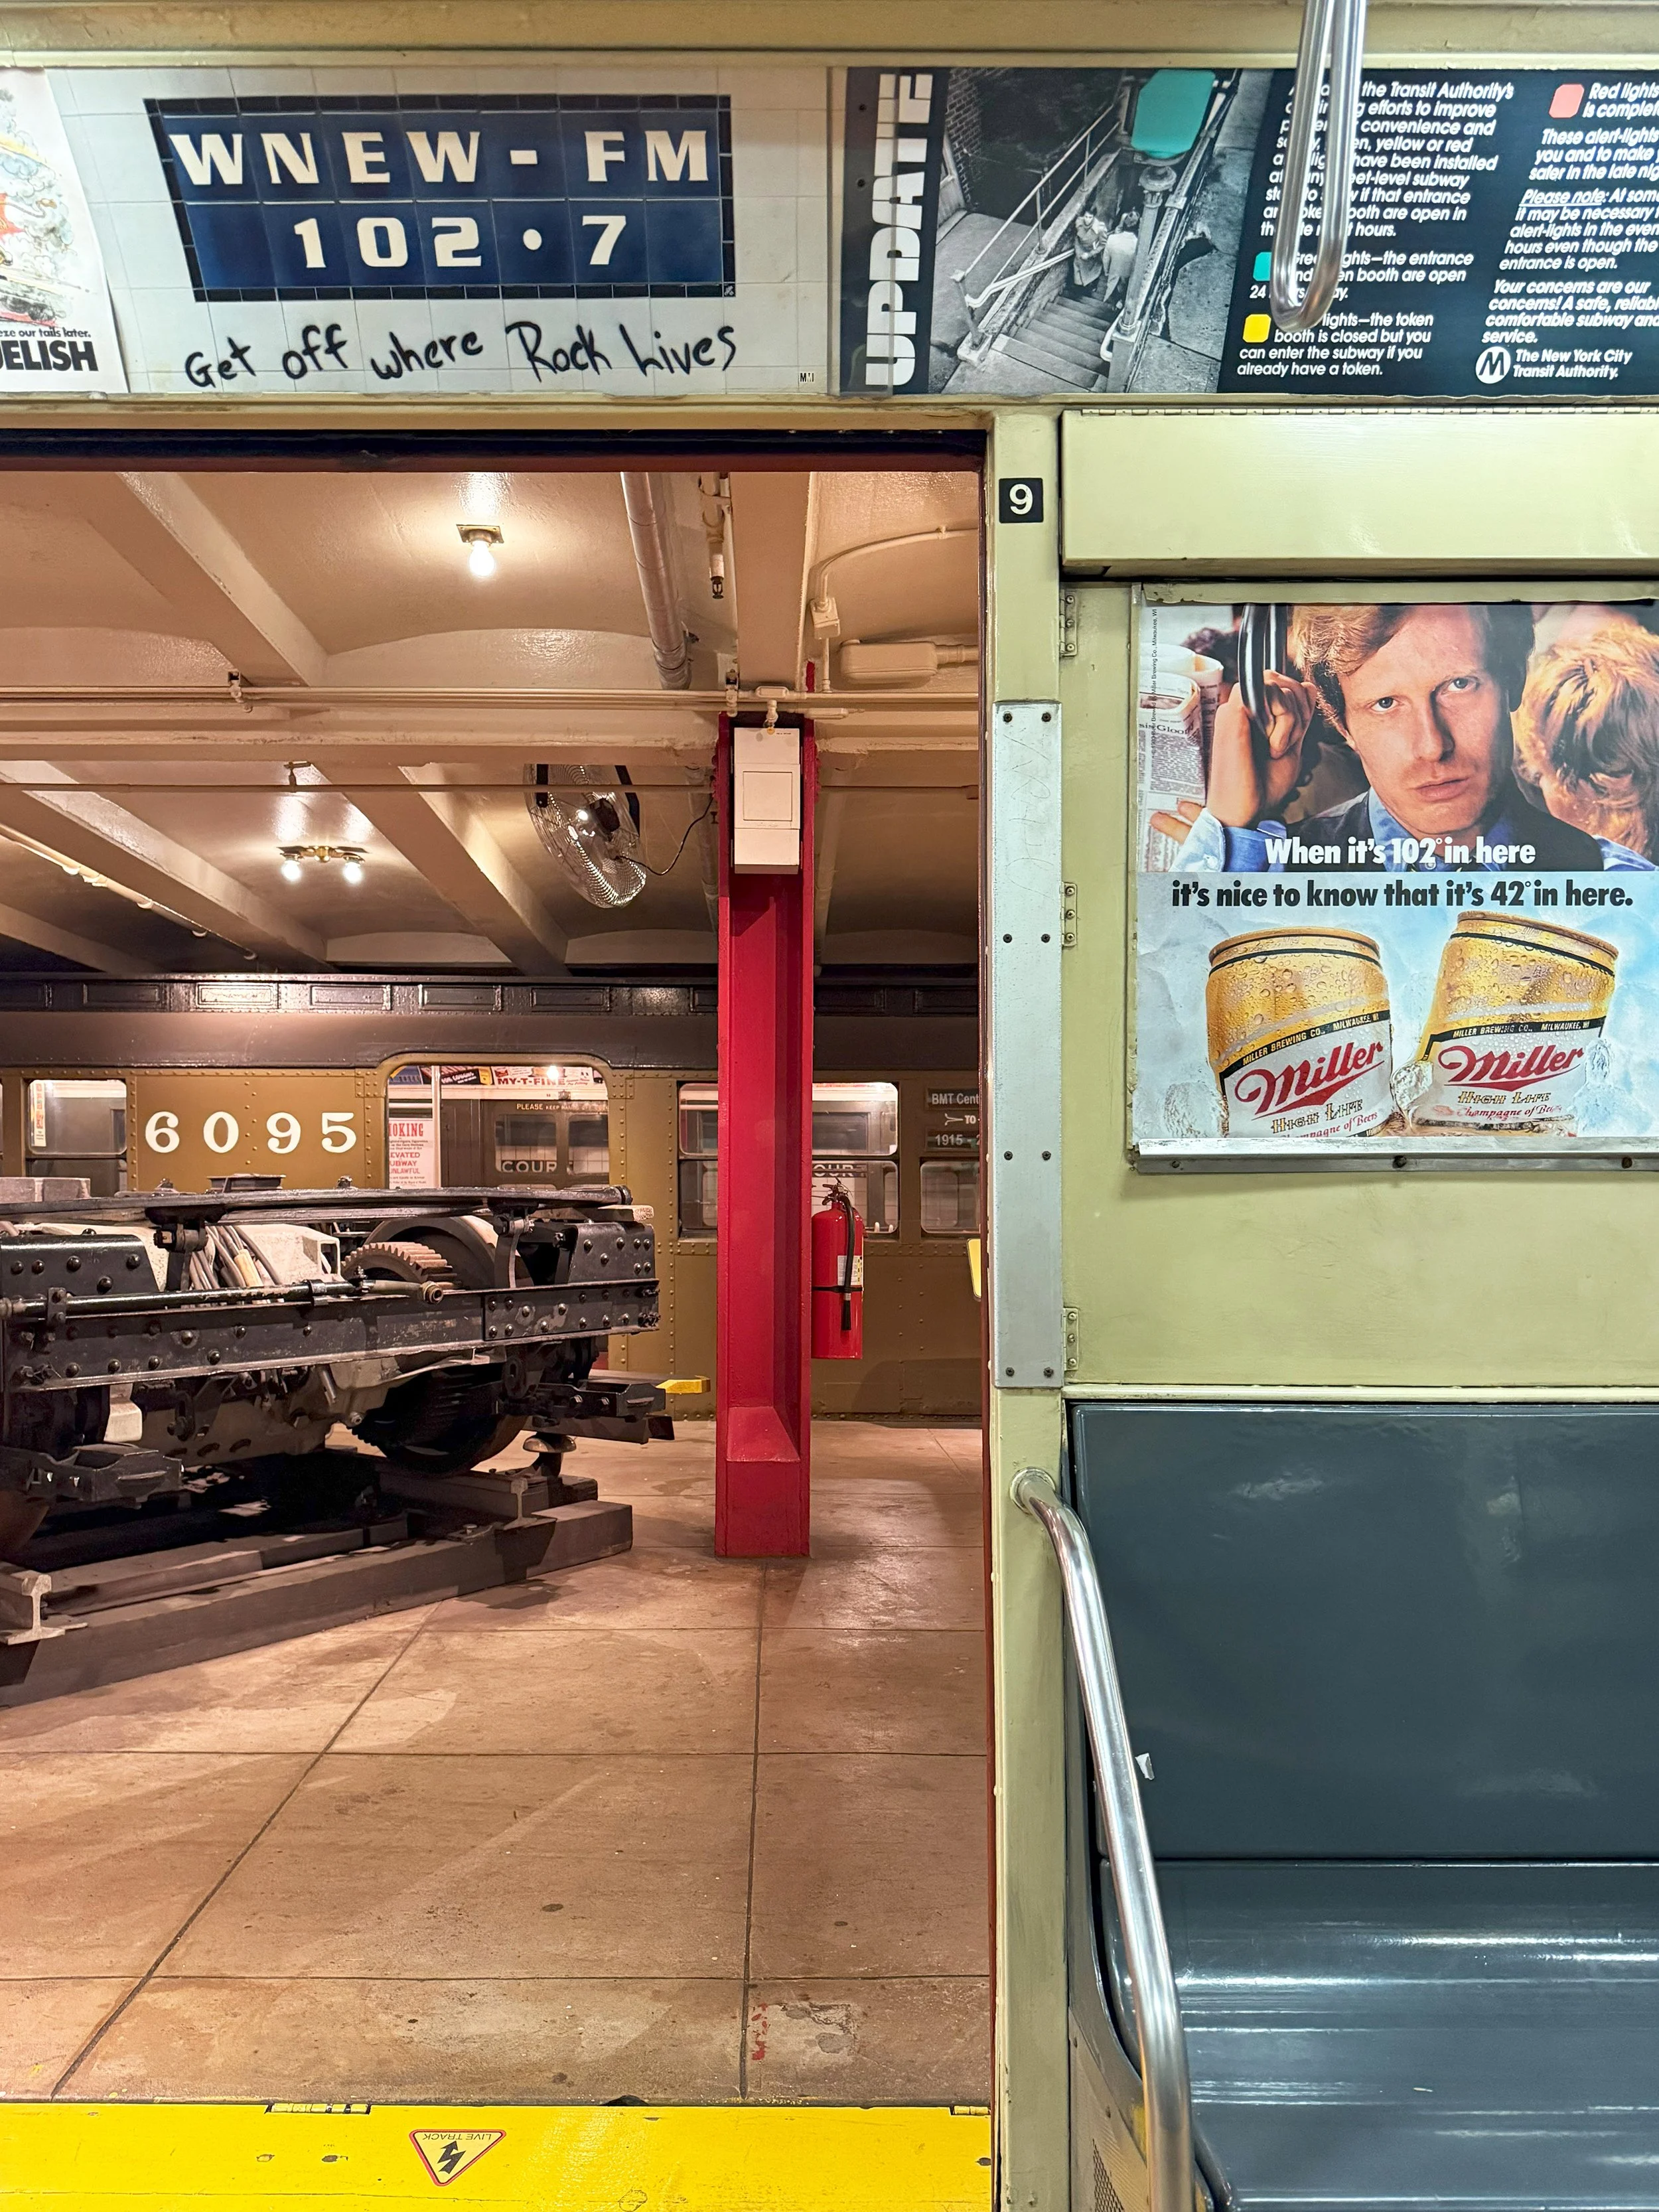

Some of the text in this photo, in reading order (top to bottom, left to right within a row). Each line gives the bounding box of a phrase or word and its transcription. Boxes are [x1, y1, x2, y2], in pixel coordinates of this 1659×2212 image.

[1362, 82, 1514, 102] the Transit Authority's
[1589, 82, 1659, 102] Red lights
[1368, 100, 1412, 115] efforts
[1416, 102, 1428, 116] to
[1433, 102, 1496, 119] improve
[1582, 101, 1595, 117] is
[1360, 119, 1460, 135] convenience
[1463, 120, 1496, 136] and
[1376, 137, 1426, 153] yellow
[1427, 139, 1444, 152] or
[1445, 138, 1474, 153] red
[1542, 127, 1659, 147] These alert-lights
[1390, 153, 1429, 169] been
[1433, 155, 1498, 171] installed
[1534, 149, 1564, 165] you
[1565, 145, 1597, 163] and
[1596, 146, 1612, 162] to
[1613, 145, 1654, 161] make
[1413, 173, 1470, 189] subway
[1529, 164, 1637, 181] safer in the late
[1361, 187, 1369, 202] if
[1372, 188, 1401, 203] that
[1404, 190, 1471, 205] entrance
[1520, 187, 1627, 204] Please note: At
[1383, 207, 1467, 223] are open in
[1514, 206, 1527, 221] it
[1527, 209, 1560, 223] may
[1559, 206, 1580, 220] be
[1581, 206, 1654, 222] necessary
[866, 73, 933, 386] UPDATE
[1354, 222, 1397, 237] hours.
[1510, 224, 1582, 240] alert-lights
[1583, 222, 1595, 236] in
[1599, 222, 1623, 236] the
[1504, 238, 1658, 256] hours even though the
[1409, 253, 1474, 266] entrance
[1499, 256, 1618, 272] entrance is open.
[1357, 267, 1398, 282] booth
[1402, 269, 1425, 282] are
[1429, 269, 1467, 285] open
[1250, 285, 1266, 299] 24
[1494, 279, 1651, 294] Your concerns are our
[1488, 295, 1612, 313] concerns! A safe,
[1396, 313, 1433, 327] token
[1485, 312, 1634, 329] comfortable subway
[39, 327, 60, 337] tails
[62, 327, 91, 337] later.
[1274, 329, 1431, 346] booth is closed but you
[1482, 329, 1538, 343] service.
[0, 340, 99, 372] ELISH
[185, 321, 736, 388] Get off where Rock Lives
[1240, 345, 1423, 362] can enter the subway if you
[1515, 349, 1632, 364] The New York City
[1237, 362, 1383, 378] already have a token.
[1513, 365, 1619, 380] Transit Authority.
[1009, 484, 1033, 514] 9
[1265, 836, 1536, 864] When it's 102° in here
[1172, 879, 1633, 907] it's nice to know that it's 42° in here.
[1453, 1028, 1477, 1039] MILLER
[1242, 1047, 1267, 1065] MILLER
[1271, 1032, 1307, 1052] BREWING
[1438, 1045, 1585, 1082] Miller
[1234, 1041, 1384, 1115] Miller
[932, 1093, 954, 1104] BMT
[1524, 1106, 1536, 1116] of
[964, 1116, 976, 1124] TO
[1344, 1118, 1353, 1132] of
[145, 1111, 356, 1153] 6095
[936, 1134, 963, 1145] 1915
